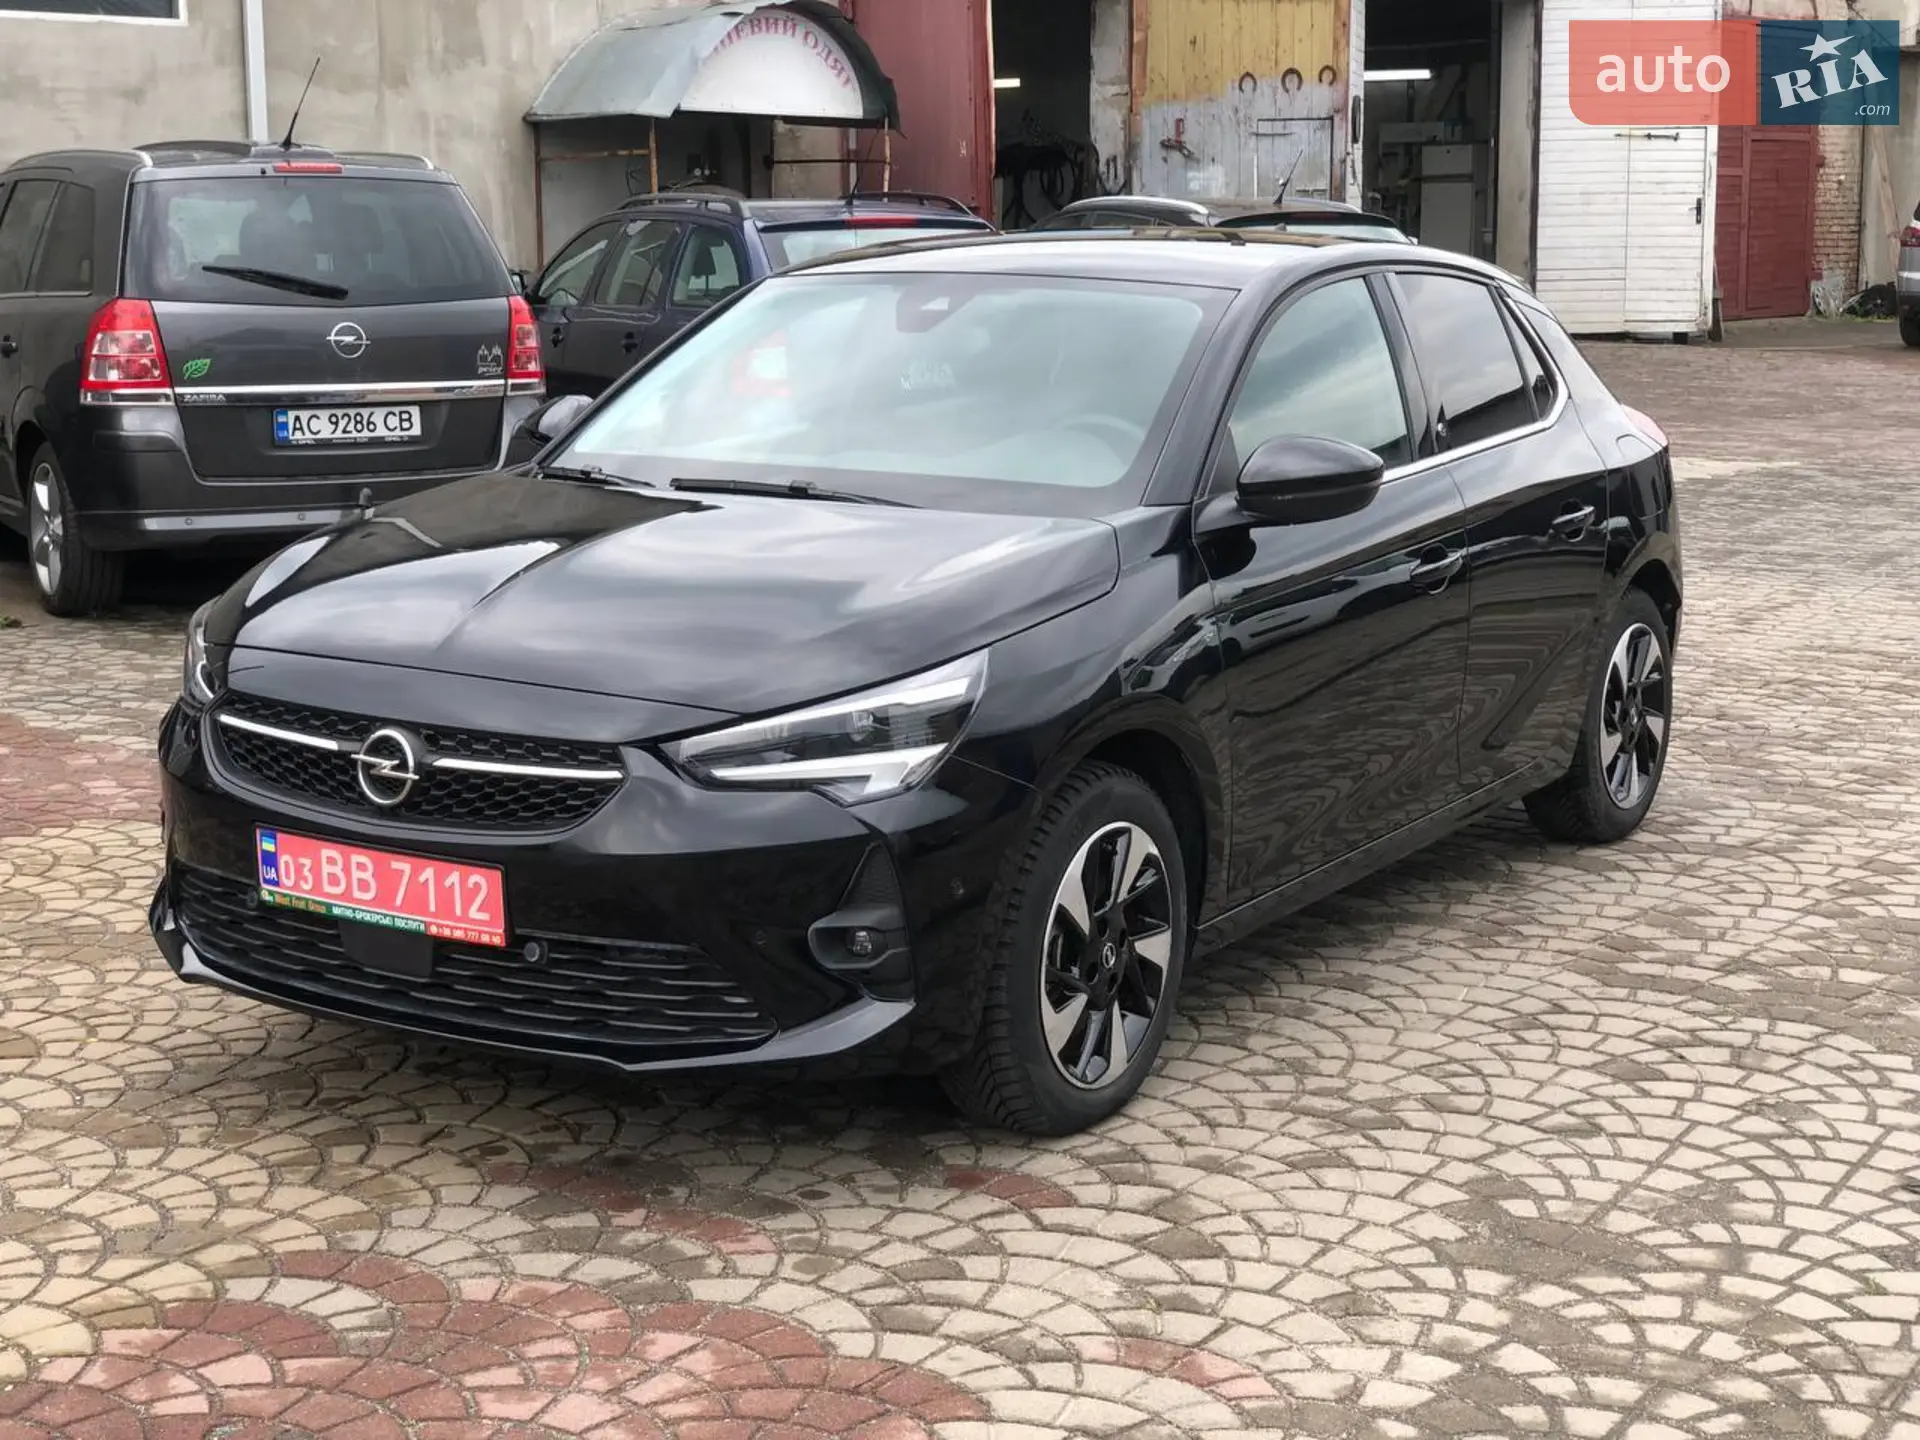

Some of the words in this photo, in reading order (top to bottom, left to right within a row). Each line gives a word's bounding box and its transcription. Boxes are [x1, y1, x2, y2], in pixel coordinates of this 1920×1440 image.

[183, 394, 227, 402] ZAFIRA
[291, 414, 321, 437] AC
[328, 411, 377, 435] 9286
[383, 410, 414, 432] CB
[263, 865, 278, 881] UA
[280, 854, 314, 890] 03
[321, 848, 377, 901] BB
[390, 860, 491, 921] 7112
